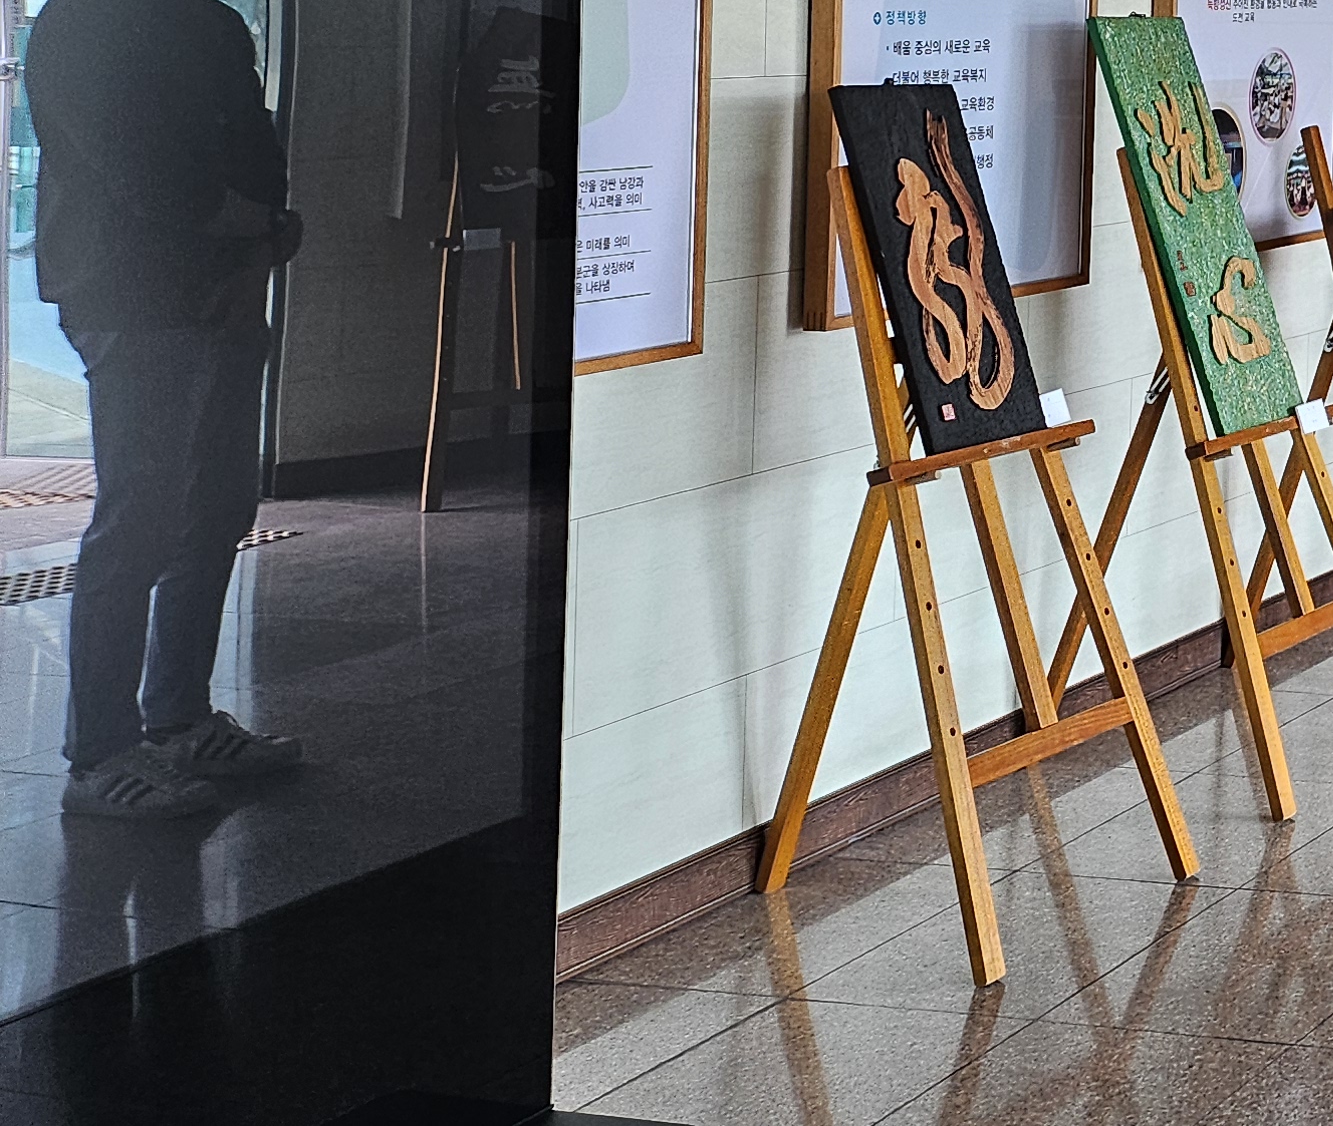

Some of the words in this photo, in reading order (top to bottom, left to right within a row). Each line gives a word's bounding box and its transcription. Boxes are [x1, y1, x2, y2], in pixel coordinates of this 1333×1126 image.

[885, 10, 927, 25] 정책방향
[893, 40, 911, 56] 배움
[914, 40, 942, 55] 중심의
[944, 39, 970, 54] 새로운
[973, 38, 991, 53] 교육
[952, 68, 987, 83] 교육복지
[960, 96, 995, 112] 교육환경
[966, 125, 993, 141] 공동체
[600, 178, 616, 192] 감싼
[619, 176, 644, 190] 남강과
[588, 193, 622, 209] 사고력을
[626, 192, 643, 206] 의미
[586, 237, 611, 252] 미래를
[614, 235, 630, 248] 의미
[586, 279, 610, 294] 나타냄
